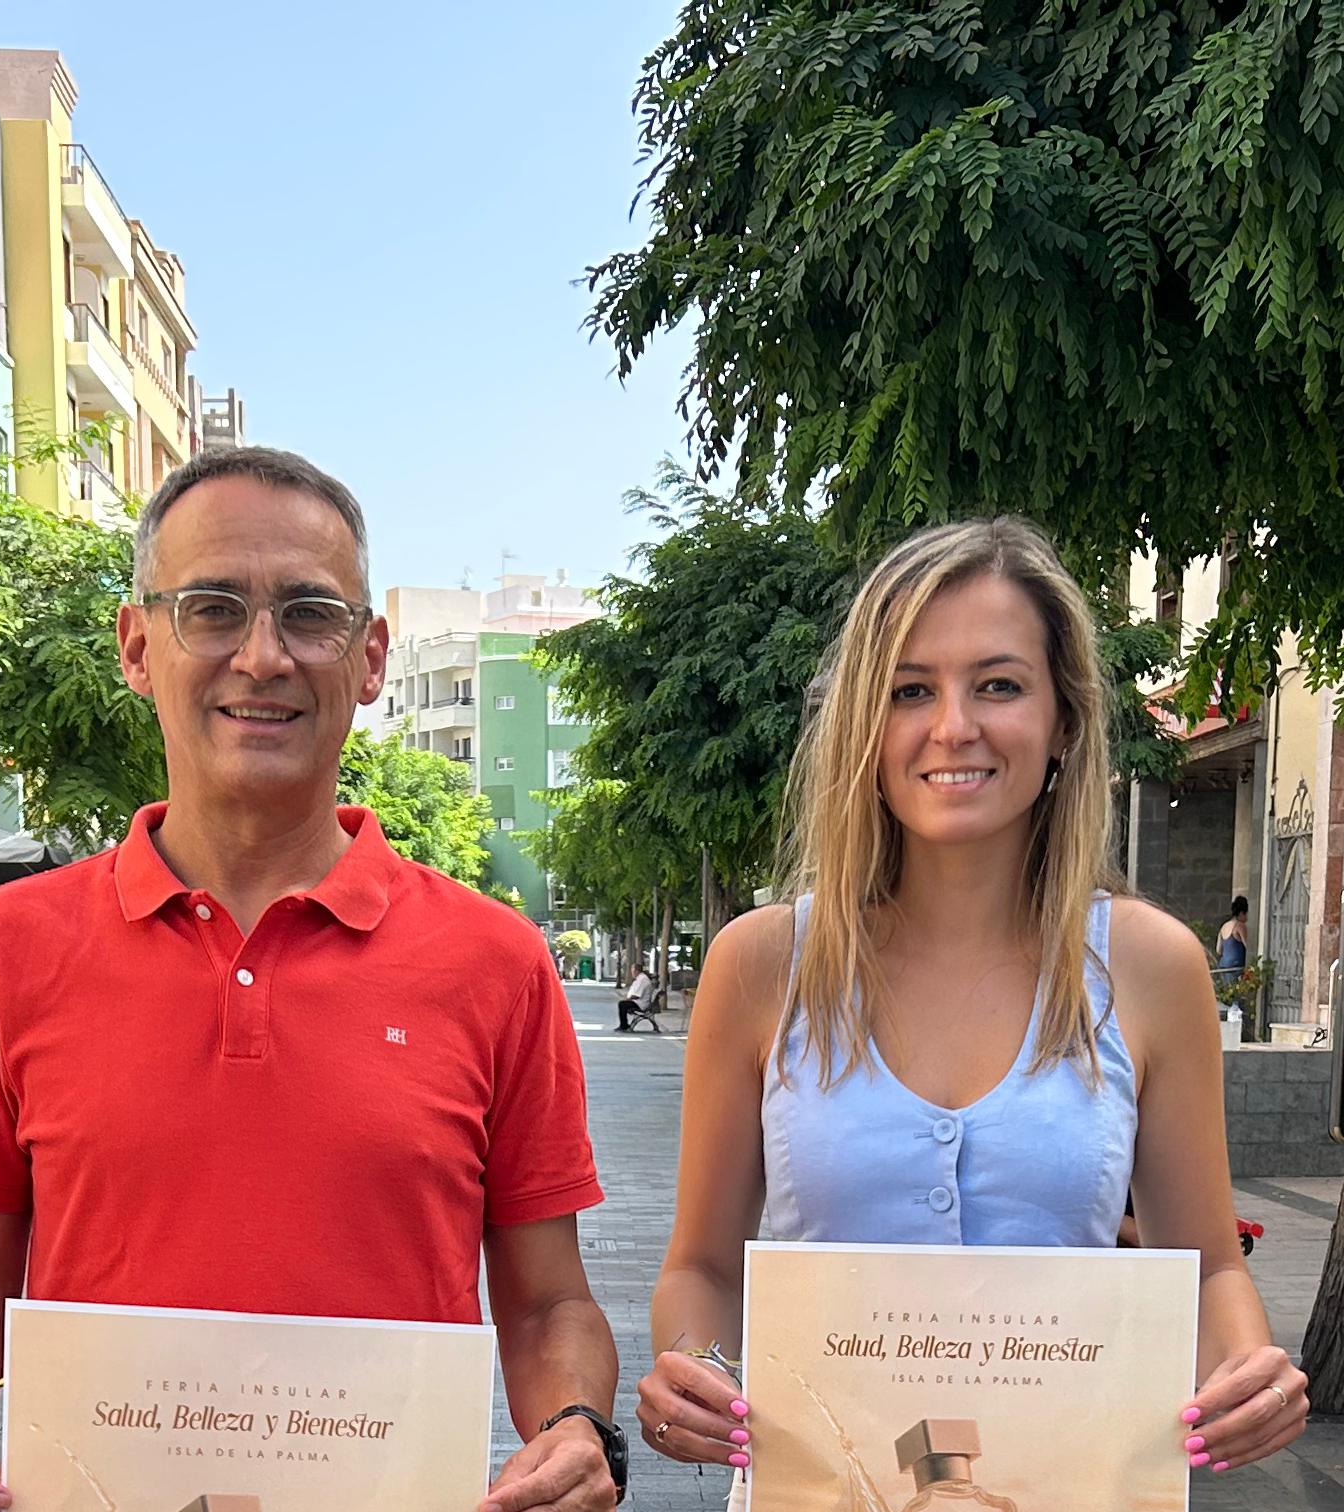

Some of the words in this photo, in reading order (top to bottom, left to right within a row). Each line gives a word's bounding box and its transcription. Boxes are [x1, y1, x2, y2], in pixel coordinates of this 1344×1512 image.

[872, 1311, 939, 1323] FERIA
[959, 1313, 1059, 1326] INSULAR
[823, 1332, 887, 1361] Salud,
[895, 1334, 972, 1360] Belleza
[978, 1342, 995, 1367] y
[1001, 1336, 1104, 1362] Bienestar
[891, 1373, 925, 1384] ISLA
[935, 1374, 953, 1385] DE
[964, 1375, 982, 1385] LA
[992, 1376, 1043, 1386] PALMA
[146, 1379, 218, 1393] FERIA
[240, 1383, 347, 1400] INSULAR
[92, 1401, 162, 1432] Salud,
[172, 1404, 254, 1432] Belleza
[261, 1414, 279, 1441] y
[285, 1409, 394, 1439] Bienestar
[167, 1446, 204, 1457] ISLA
[215, 1447, 235, 1458] DE
[247, 1449, 265, 1459] LA
[276, 1450, 330, 1462] PALMA
